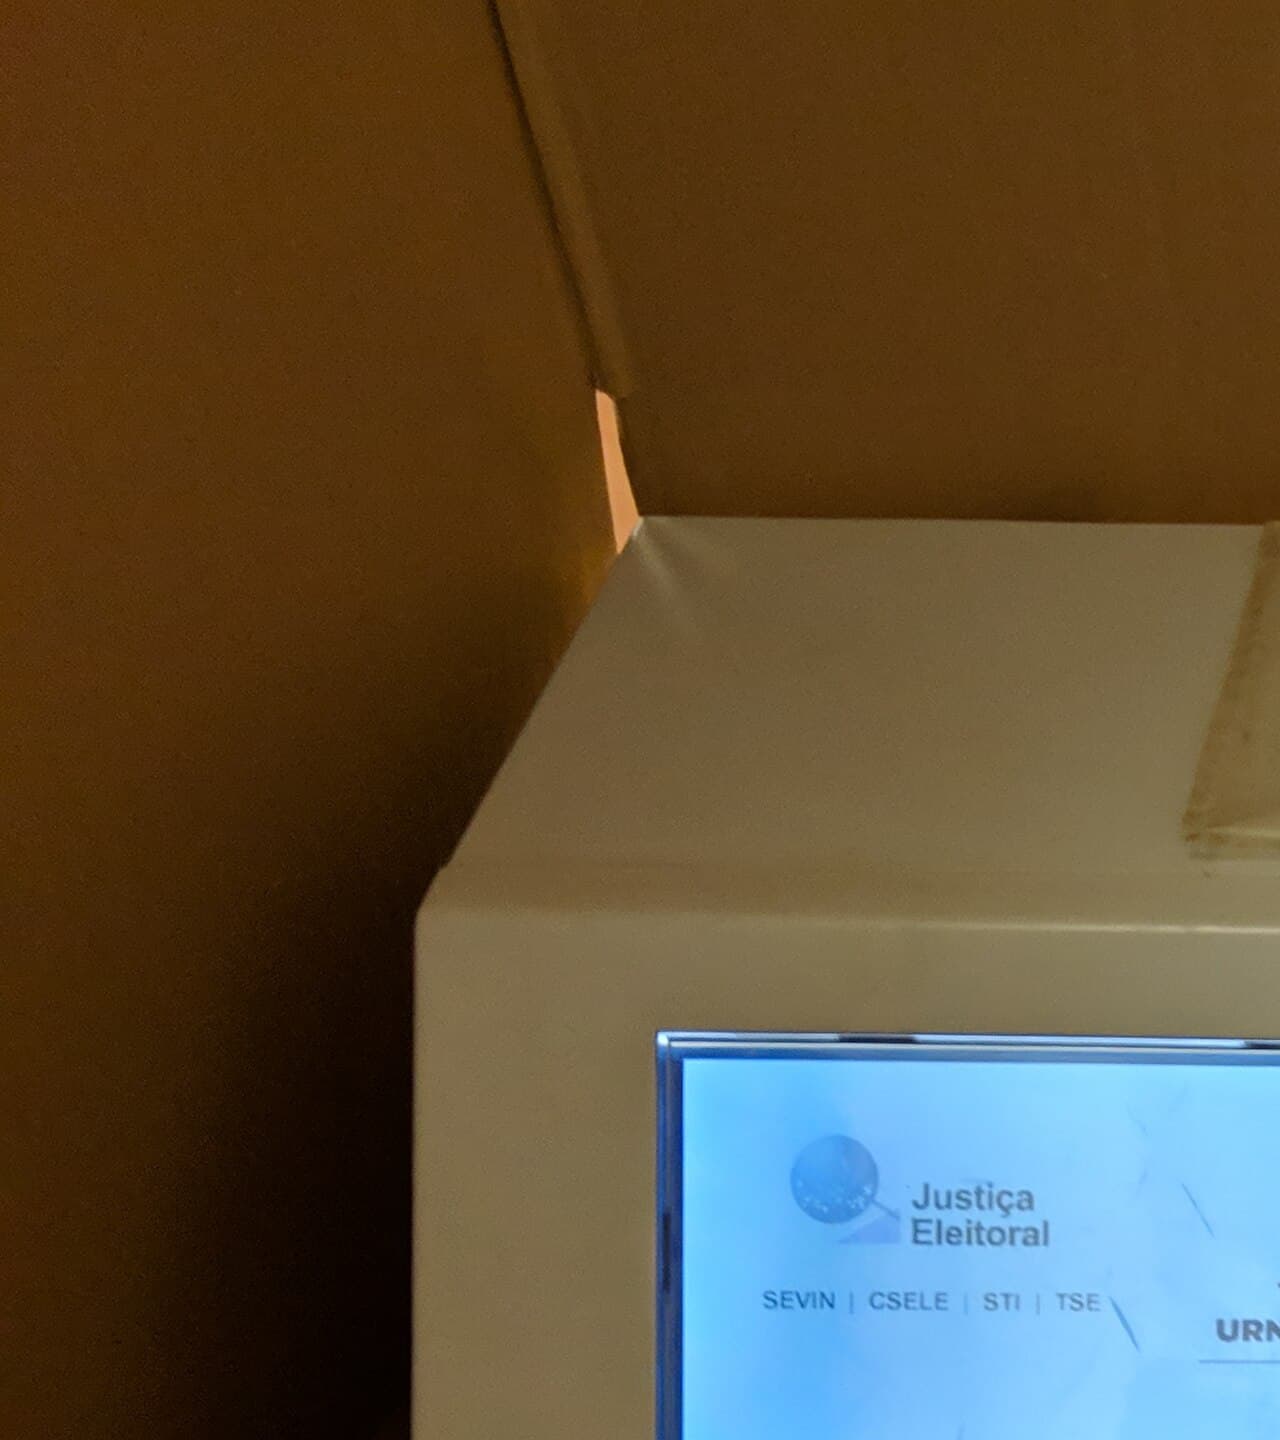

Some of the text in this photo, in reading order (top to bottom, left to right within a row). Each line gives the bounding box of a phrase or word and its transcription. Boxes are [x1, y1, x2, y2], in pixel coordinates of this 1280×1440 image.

[912, 1182, 1036, 1215] Justiça
[912, 1218, 1050, 1248] Eleitoral
[763, 1291, 836, 1309] SEVIN
[869, 1291, 949, 1311] CSELE
[983, 1293, 1021, 1312] STI
[1056, 1293, 1101, 1312] TSE
